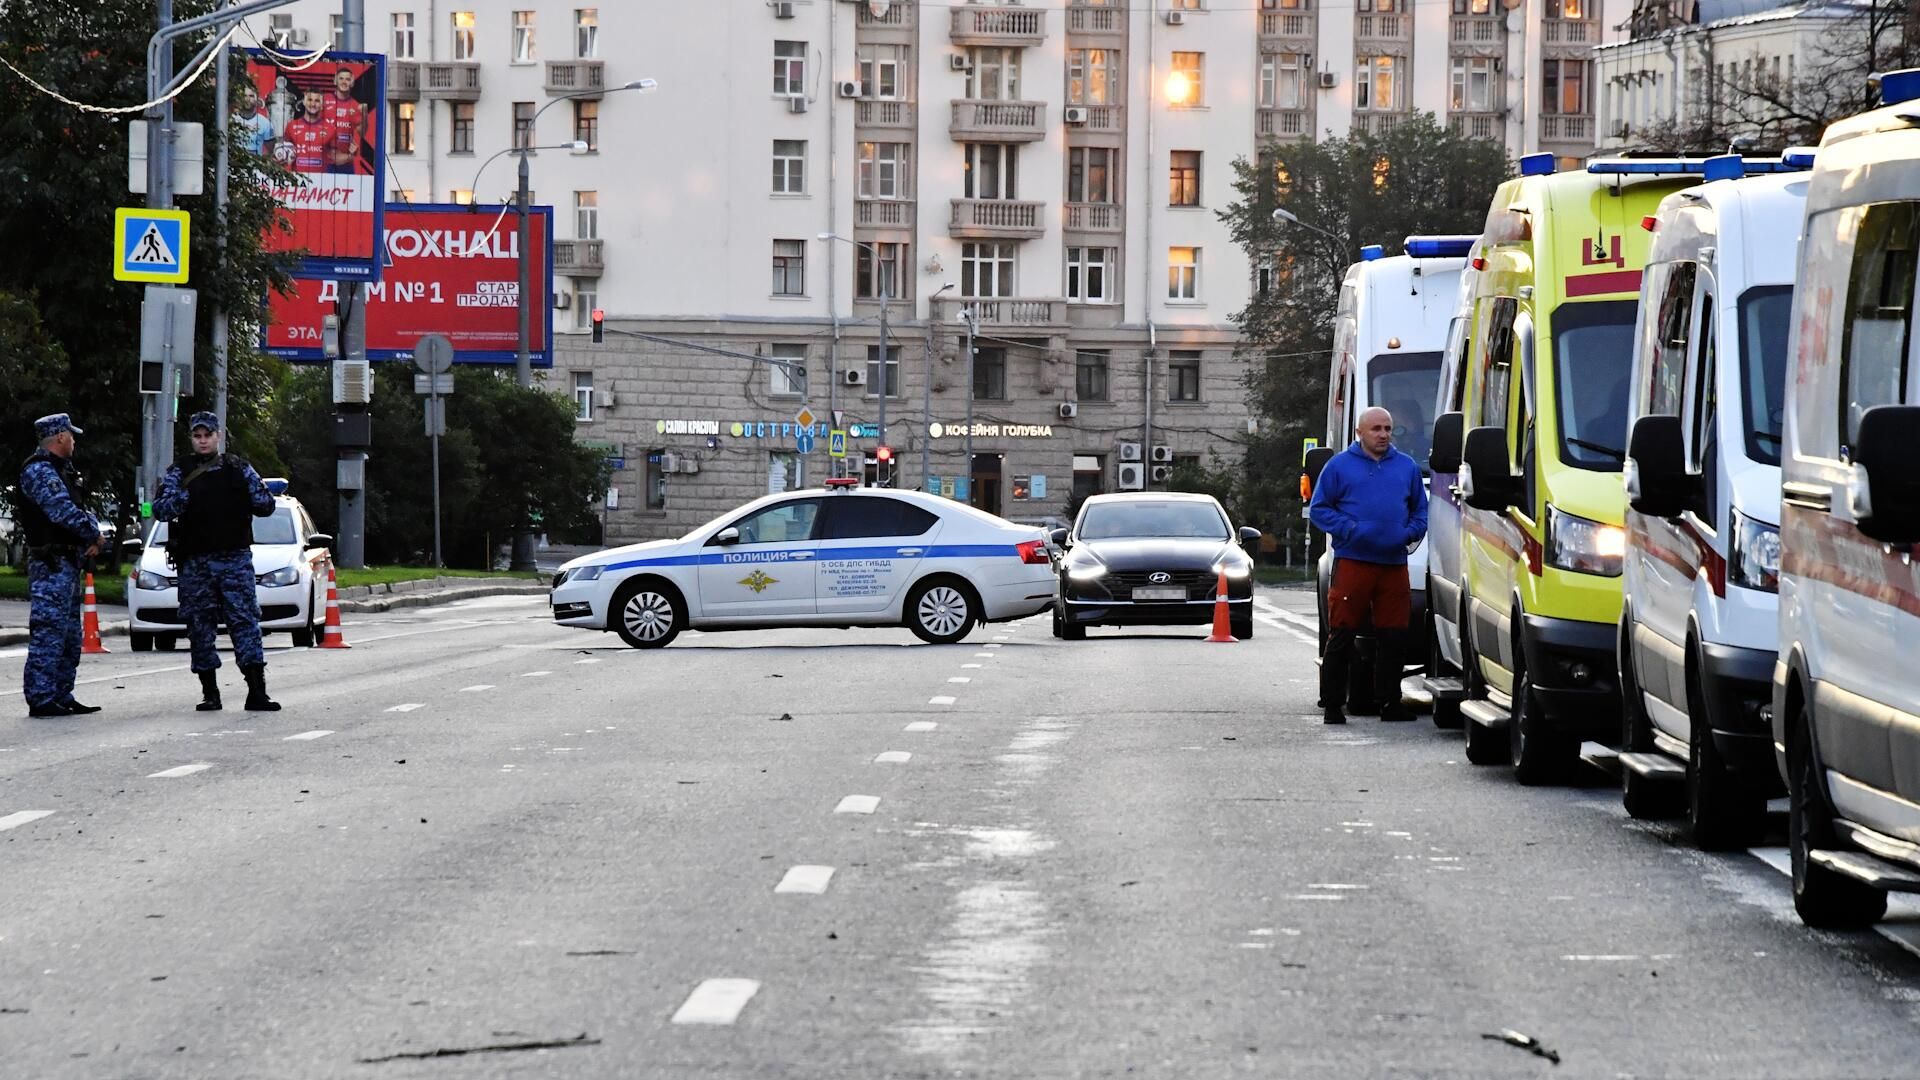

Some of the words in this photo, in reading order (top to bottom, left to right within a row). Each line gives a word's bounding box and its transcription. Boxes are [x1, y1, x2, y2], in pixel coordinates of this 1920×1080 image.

[1582, 235, 1625, 268] Ц
[318, 280, 386, 304] ДМ
[665, 420, 687, 434] САЛОН
[688, 421, 719, 435] КРАСОТЫ
[1003, 425, 1052, 437] ГОЛУБКА
[723, 552, 788, 563] ПОЛИЦИЯ
[847, 560, 863, 568] ДПС
